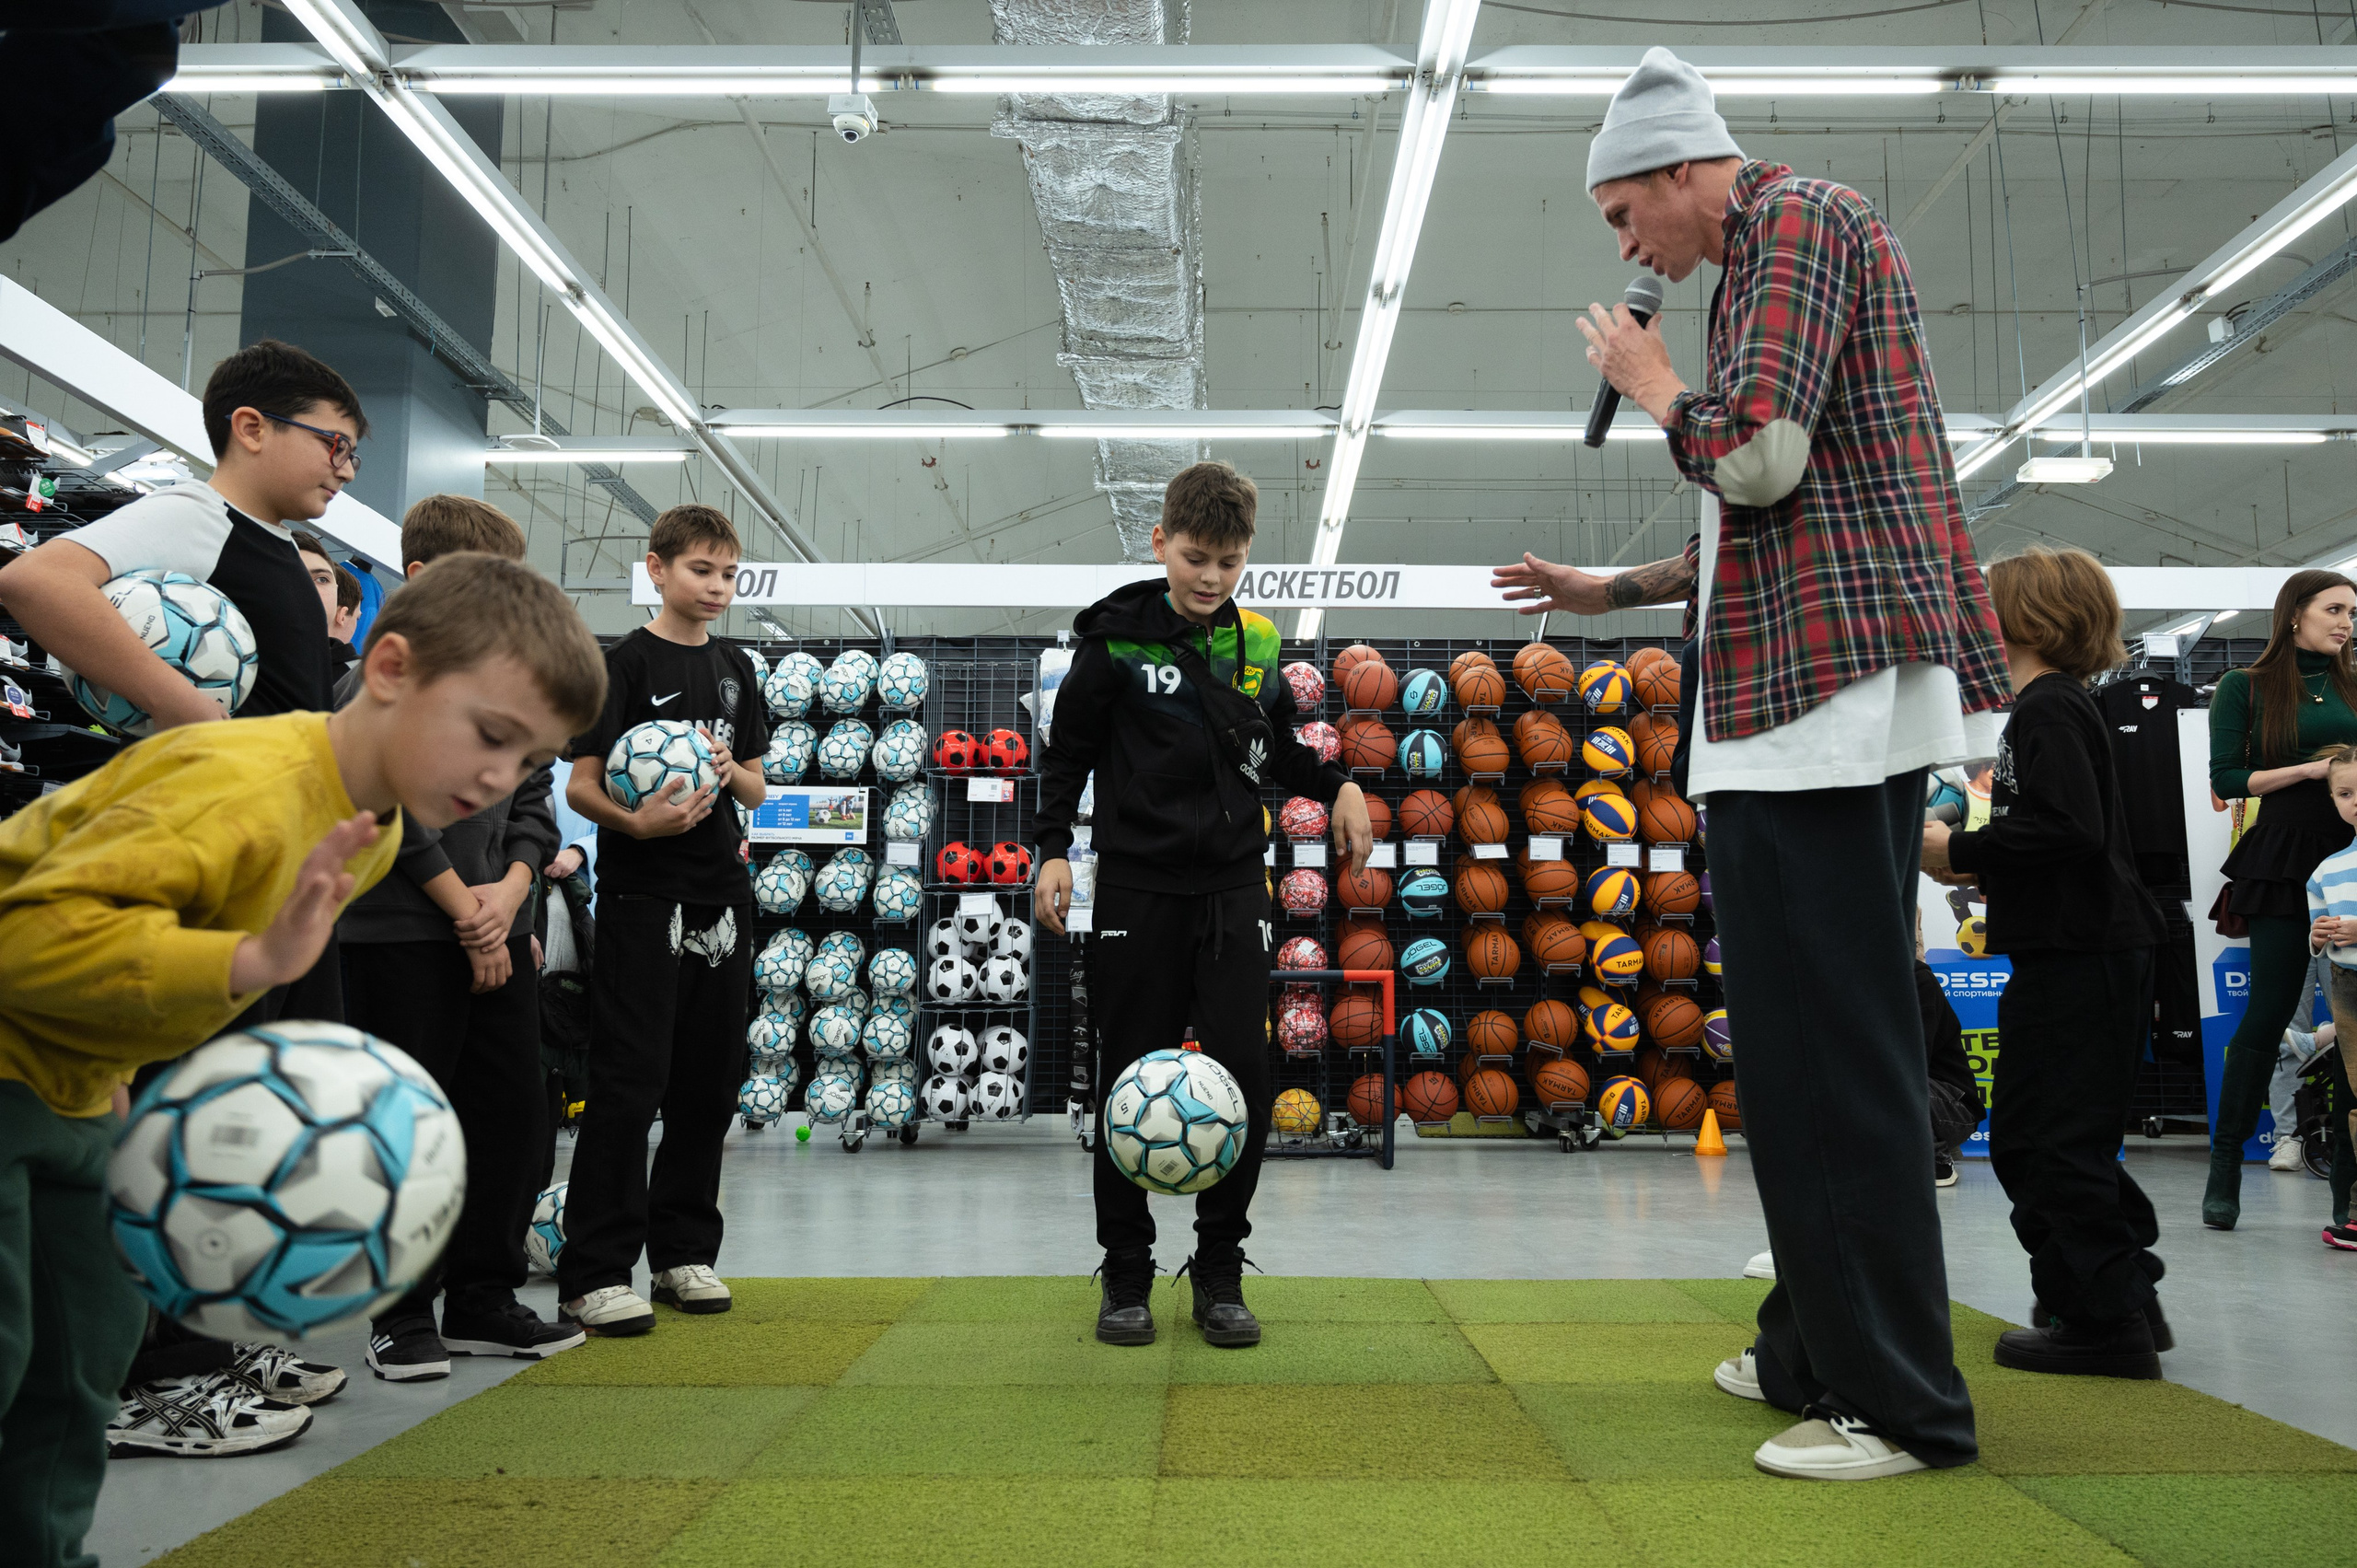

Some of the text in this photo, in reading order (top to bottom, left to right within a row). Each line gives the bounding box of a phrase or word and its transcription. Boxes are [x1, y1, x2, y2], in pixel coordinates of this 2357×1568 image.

[1234, 570, 1401, 599] АСКЕТБОЛ
[139, 614, 156, 641] NUENO
[1140, 663, 1182, 695] 19
[1415, 882, 1446, 893] JÖGEL
[1458, 877, 1479, 910] TARMAK
[1405, 940, 1437, 961] JÖGEL
[831, 1021, 844, 1044] JÖGEL
[1197, 1080, 1213, 1101] NUENO
[1542, 1076, 1577, 1097] TARMAK
[826, 1090, 849, 1105] JÖGEL
[1676, 1090, 1703, 1121] TARMAK
[1709, 1098, 1739, 1111] ARMAK
[1120, 1102, 1130, 1115] 5
